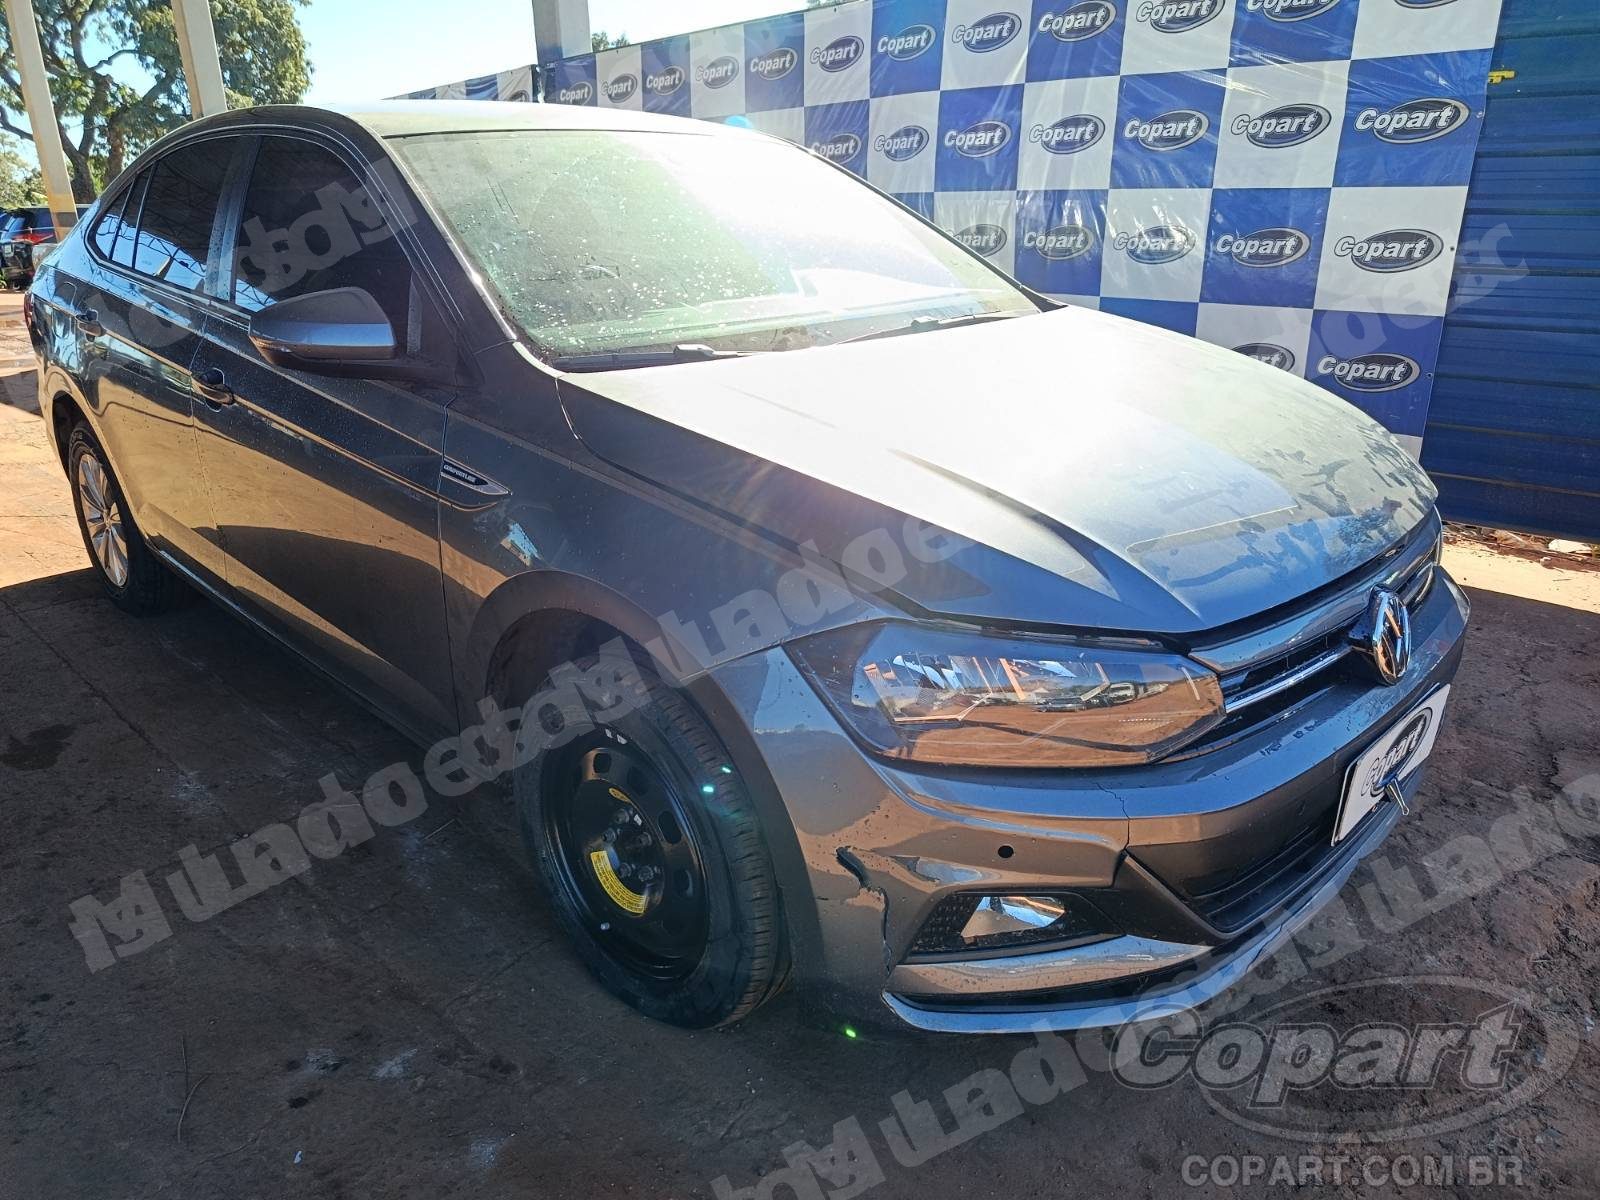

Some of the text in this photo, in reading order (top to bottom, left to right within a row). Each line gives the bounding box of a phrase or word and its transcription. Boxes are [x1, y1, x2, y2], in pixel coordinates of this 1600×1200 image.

[1039, 8, 1106, 34] Copart
[1136, 0, 1212, 23] Copart
[877, 30, 929, 54] Copart
[952, 19, 1012, 48] Copart
[751, 52, 791, 73] Copart
[810, 41, 857, 64] Copart
[646, 73, 681, 90] Copart
[695, 63, 733, 82] Copart
[560, 87, 588, 102] Copart
[601, 80, 632, 96] Copart
[1124, 116, 1202, 146] Copart
[1231, 112, 1319, 139] Copart
[1355, 103, 1455, 133] Copart
[874, 130, 922, 156] Copart
[944, 126, 1001, 152] Copart
[1029, 121, 1097, 149] Copart
[1024, 231, 1085, 254] Copart
[1114, 229, 1193, 256] Copart
[1216, 233, 1300, 259] Copart
[1334, 234, 1429, 263] Copart
[1317, 353, 1409, 384] Copart
[1361, 714, 1426, 796] Copart
